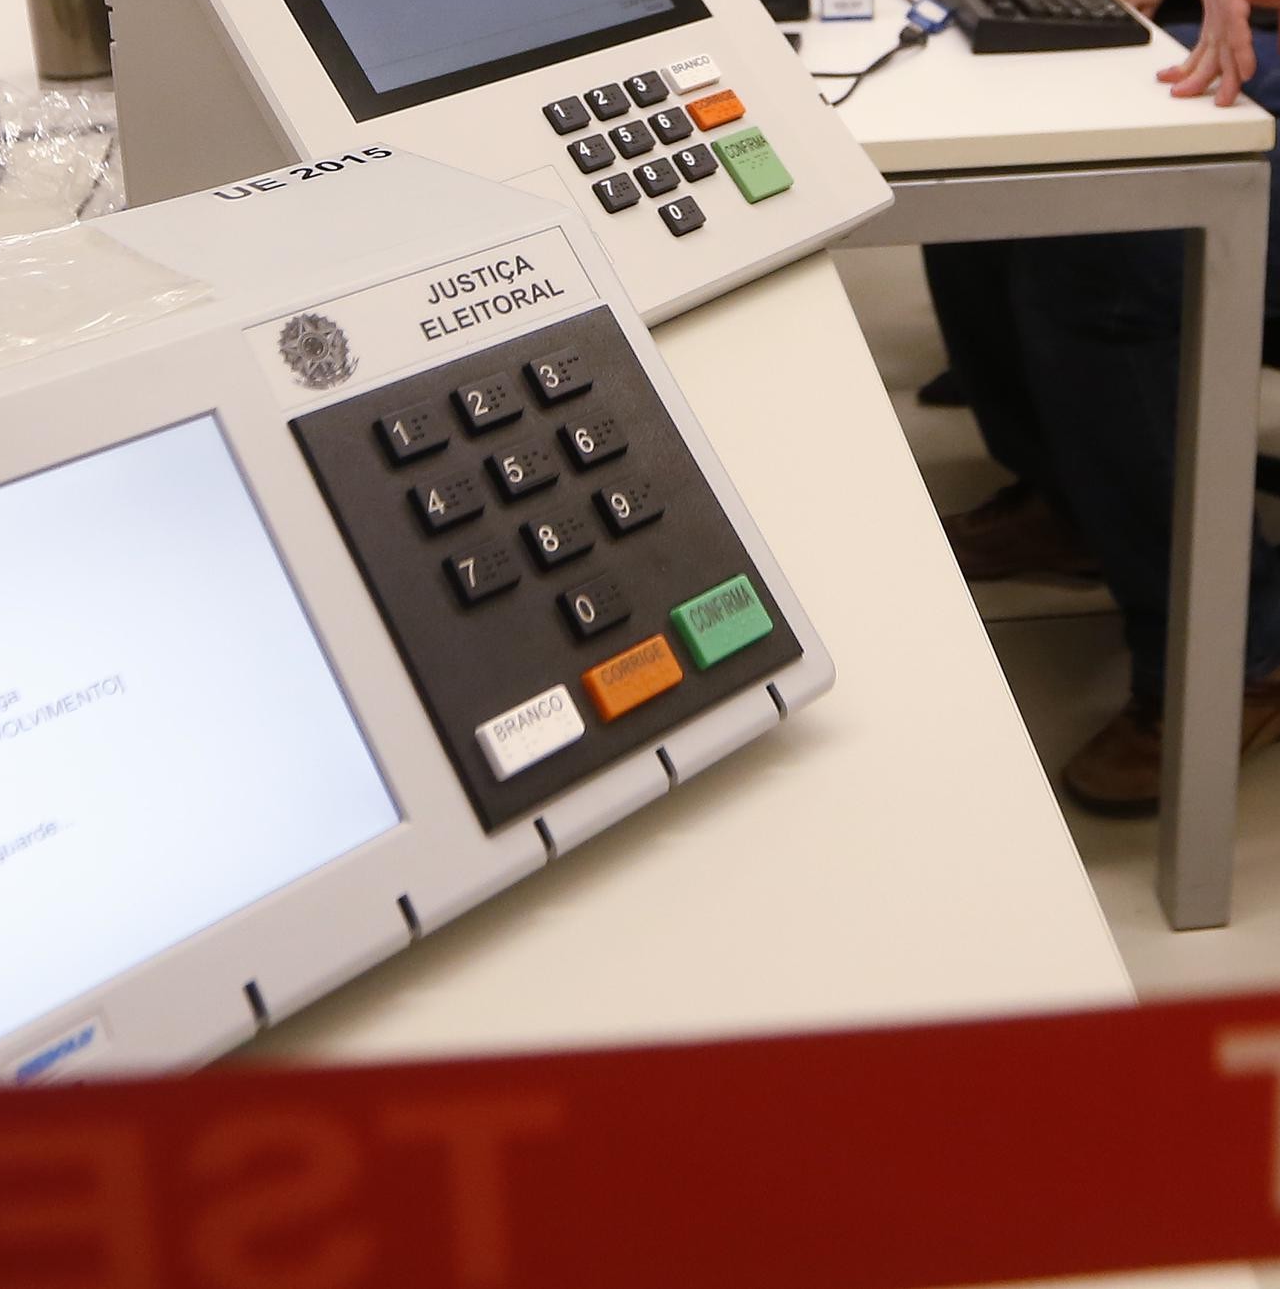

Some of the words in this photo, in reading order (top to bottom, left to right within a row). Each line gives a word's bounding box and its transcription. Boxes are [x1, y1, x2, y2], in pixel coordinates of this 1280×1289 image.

[553, 102, 566, 119] 1
[593, 89, 608, 106] 2
[632, 77, 648, 93] 3
[670, 55, 711, 75] BRANCO
[578, 142, 592, 158] 4
[618, 127, 632, 143] 5
[657, 113, 672, 129] 6
[600, 180, 615, 197] 7
[643, 165, 658, 181] 8
[681, 151, 696, 167] 9
[724, 133, 769, 160] CONFIRMA
[213, 177, 287, 200] UE
[290, 146, 394, 181] 2015
[668, 204, 683, 221] 0
[419, 278, 565, 342] ELEITORAL
[427, 254, 535, 305] JUSTIÇA
[392, 420, 412, 446] 1
[467, 390, 489, 417] 2
[539, 364, 560, 388] 3
[427, 489, 447, 515] 4
[503, 456, 524, 484] 5
[574, 428, 596, 454] 6
[458, 558, 477, 588] 7
[538, 524, 560, 553] 8
[610, 492, 631, 519] 9
[574, 593, 596, 624] 0
[492, 694, 564, 745] BRANCO
[600, 642, 665, 687] CORRIGE
[688, 583, 753, 634] CONFIRMA
